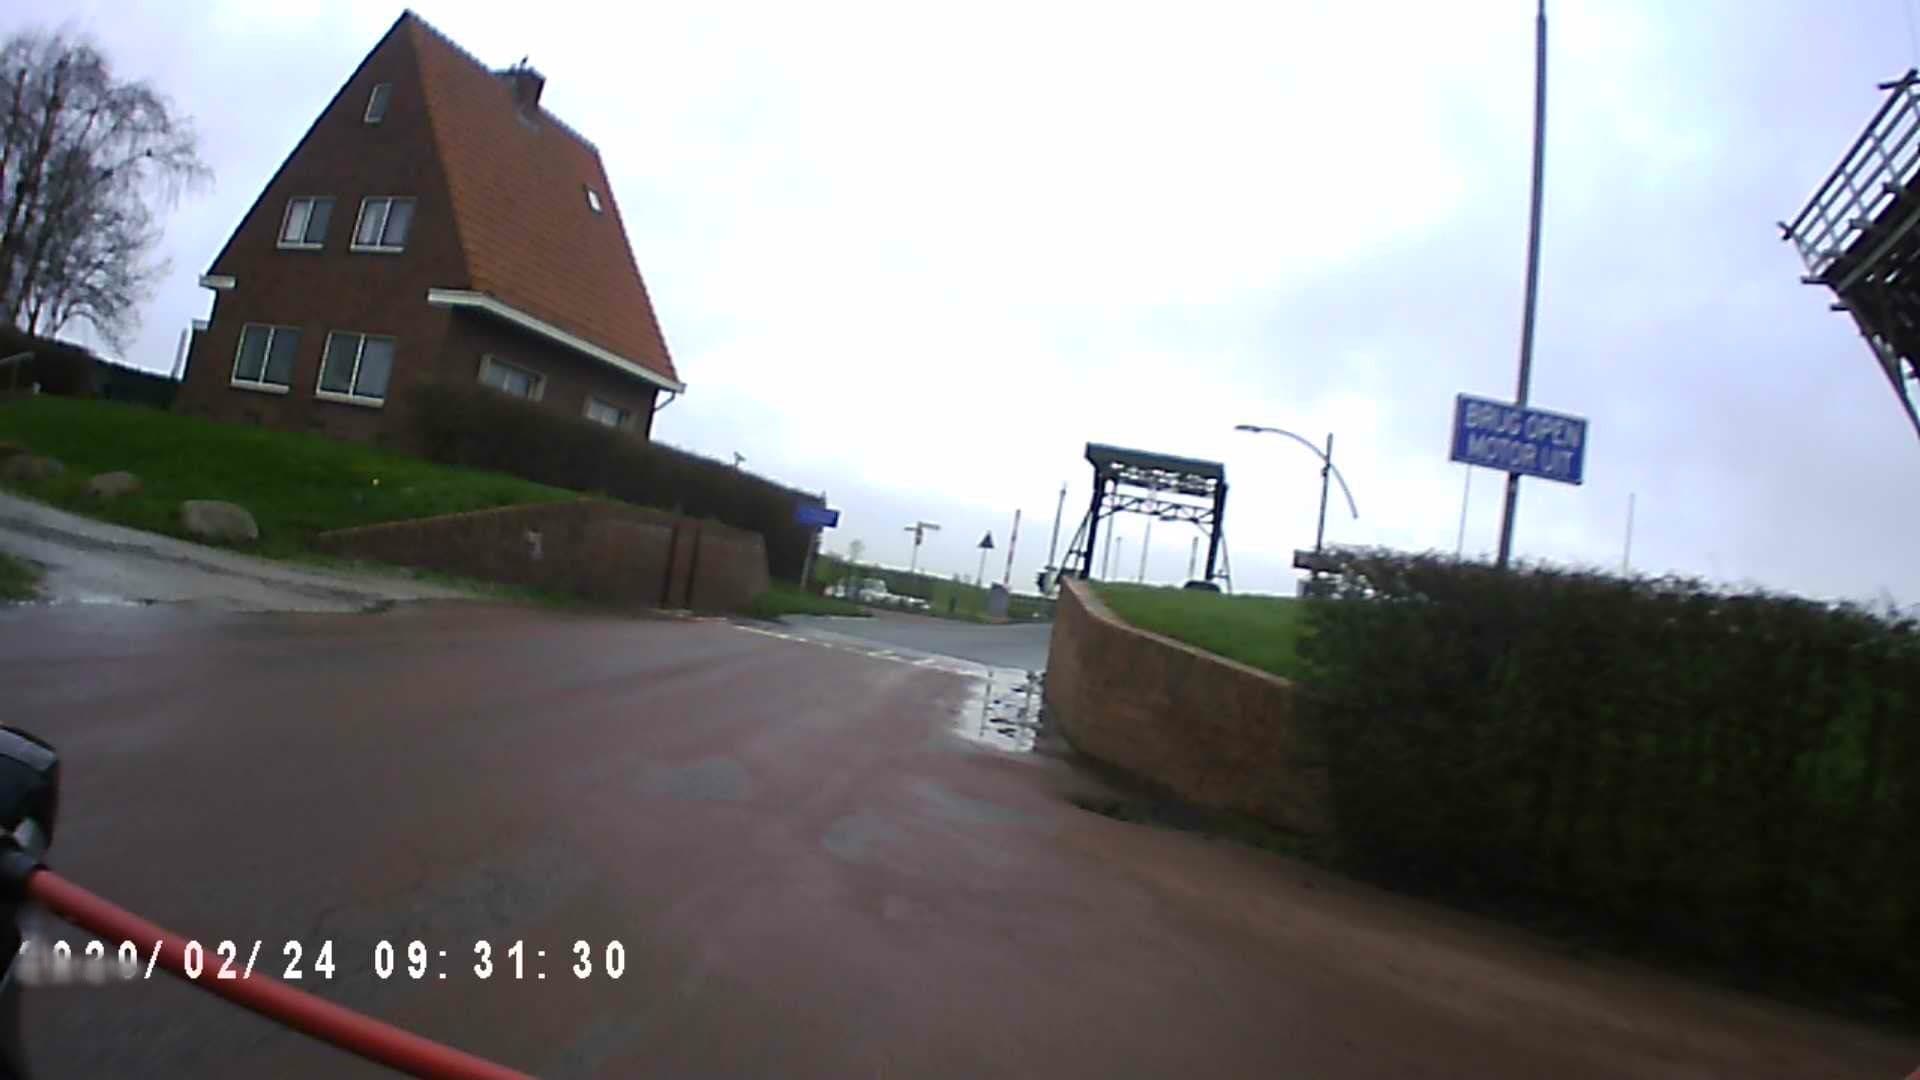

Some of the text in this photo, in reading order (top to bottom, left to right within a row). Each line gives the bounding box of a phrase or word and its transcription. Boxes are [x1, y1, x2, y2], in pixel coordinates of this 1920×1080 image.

[1465, 402, 1581, 450] BRUG OPEN
[1467, 432, 1574, 475] MOTOR UIT
